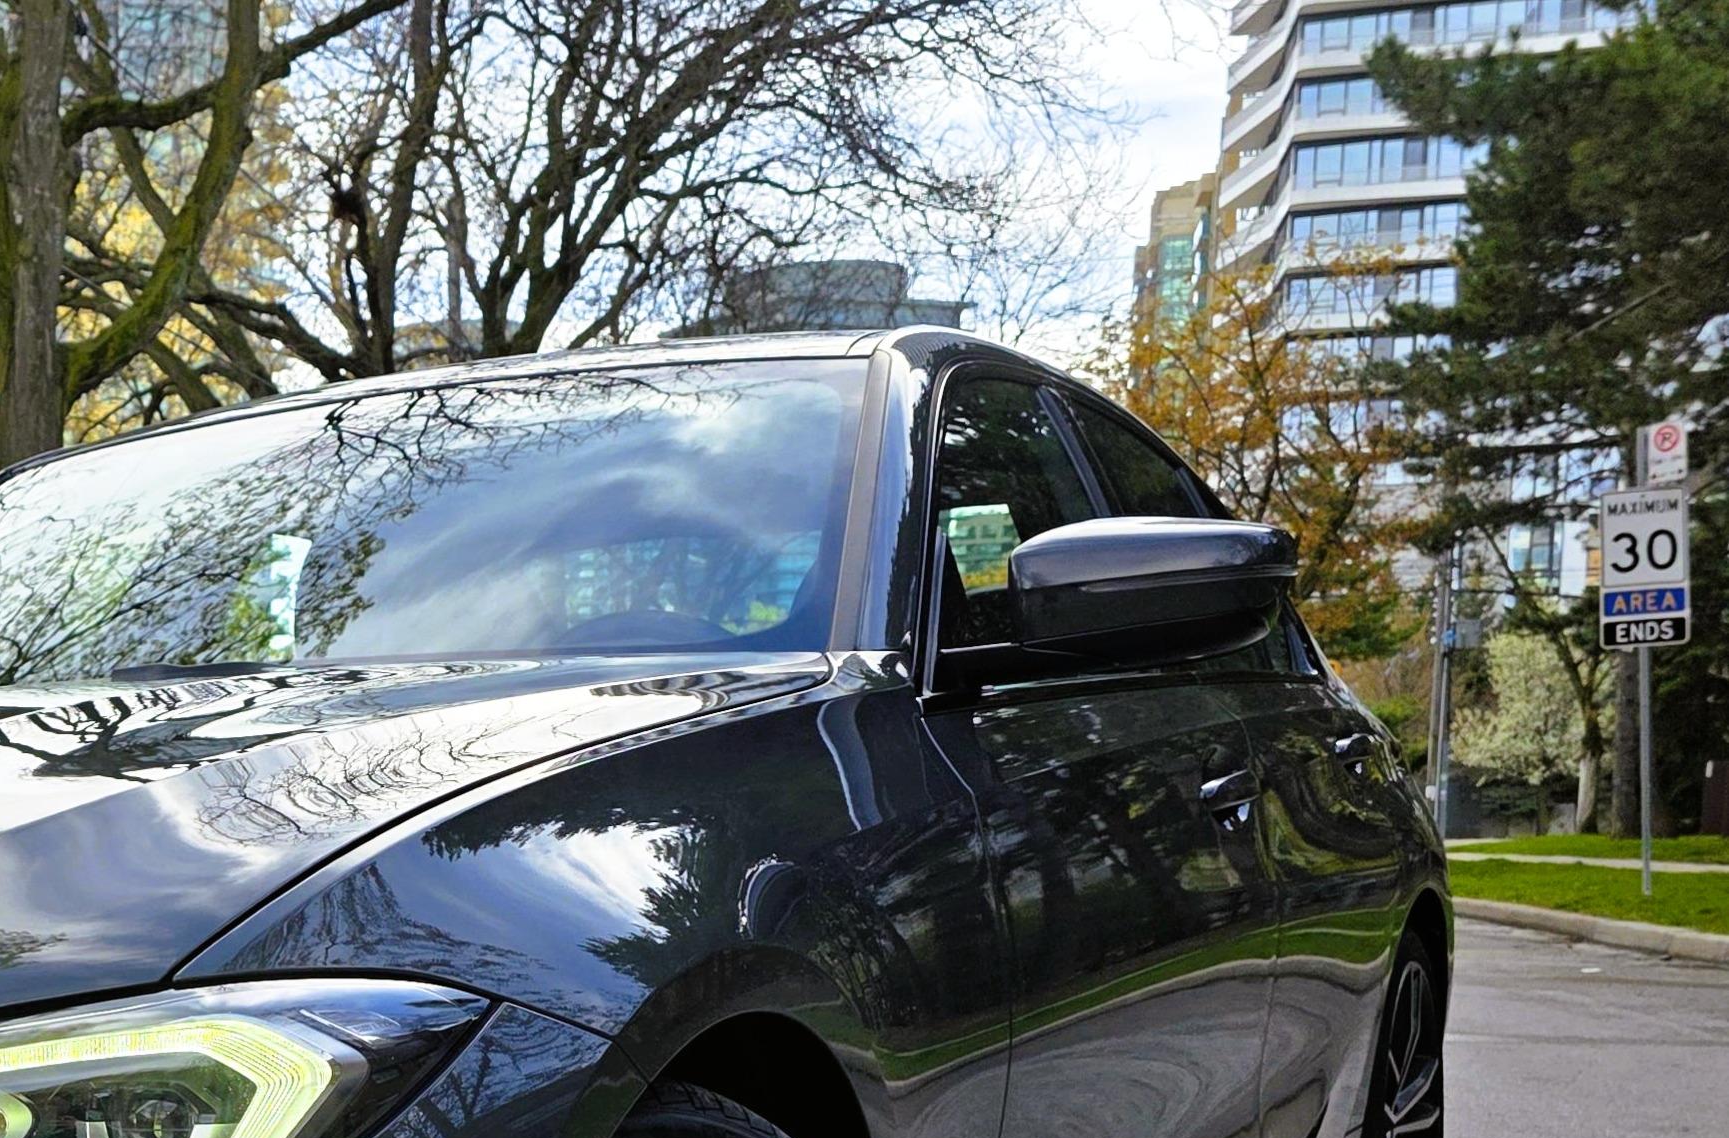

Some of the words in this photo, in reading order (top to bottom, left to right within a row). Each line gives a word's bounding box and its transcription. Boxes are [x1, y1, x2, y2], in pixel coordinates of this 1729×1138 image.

[1607, 499, 1678, 516] MAXIMUM
[1611, 529, 1677, 573] 30
[1612, 591, 1677, 614] AREA
[1615, 620, 1674, 643] ENDS
